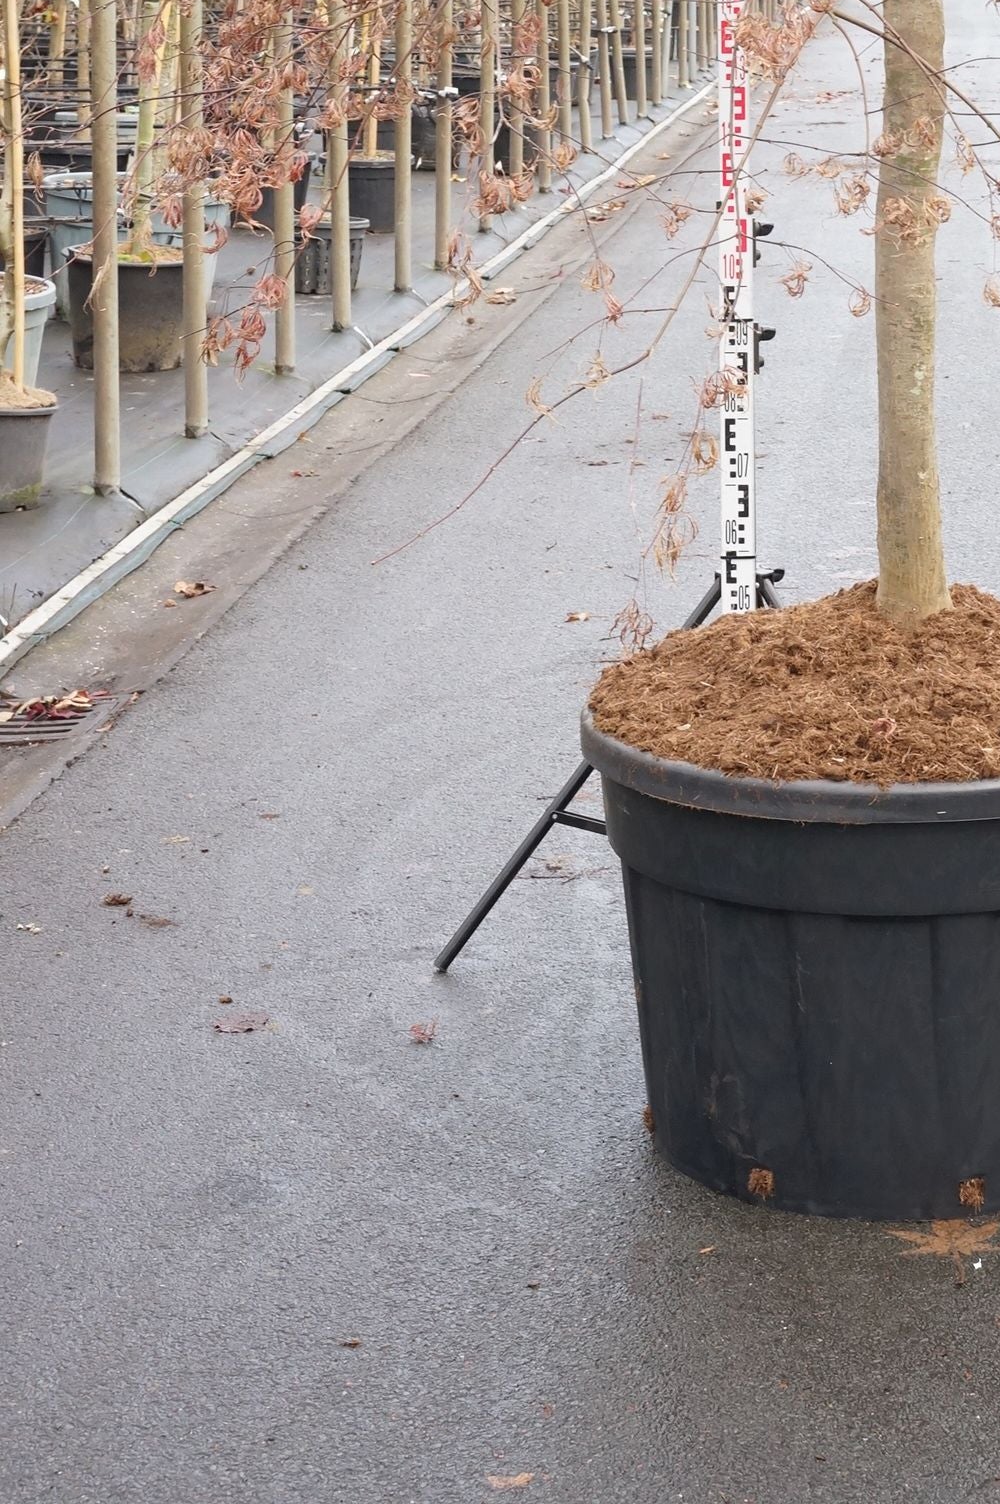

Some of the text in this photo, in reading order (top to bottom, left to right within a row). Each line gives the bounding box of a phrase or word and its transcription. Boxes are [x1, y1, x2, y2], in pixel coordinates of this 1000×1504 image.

[723, 254, 734, 281] 10
[737, 321, 748, 346] 09
[737, 453, 748, 478] 07
[725, 520, 736, 545] 06
[739, 585, 750, 610] 05
